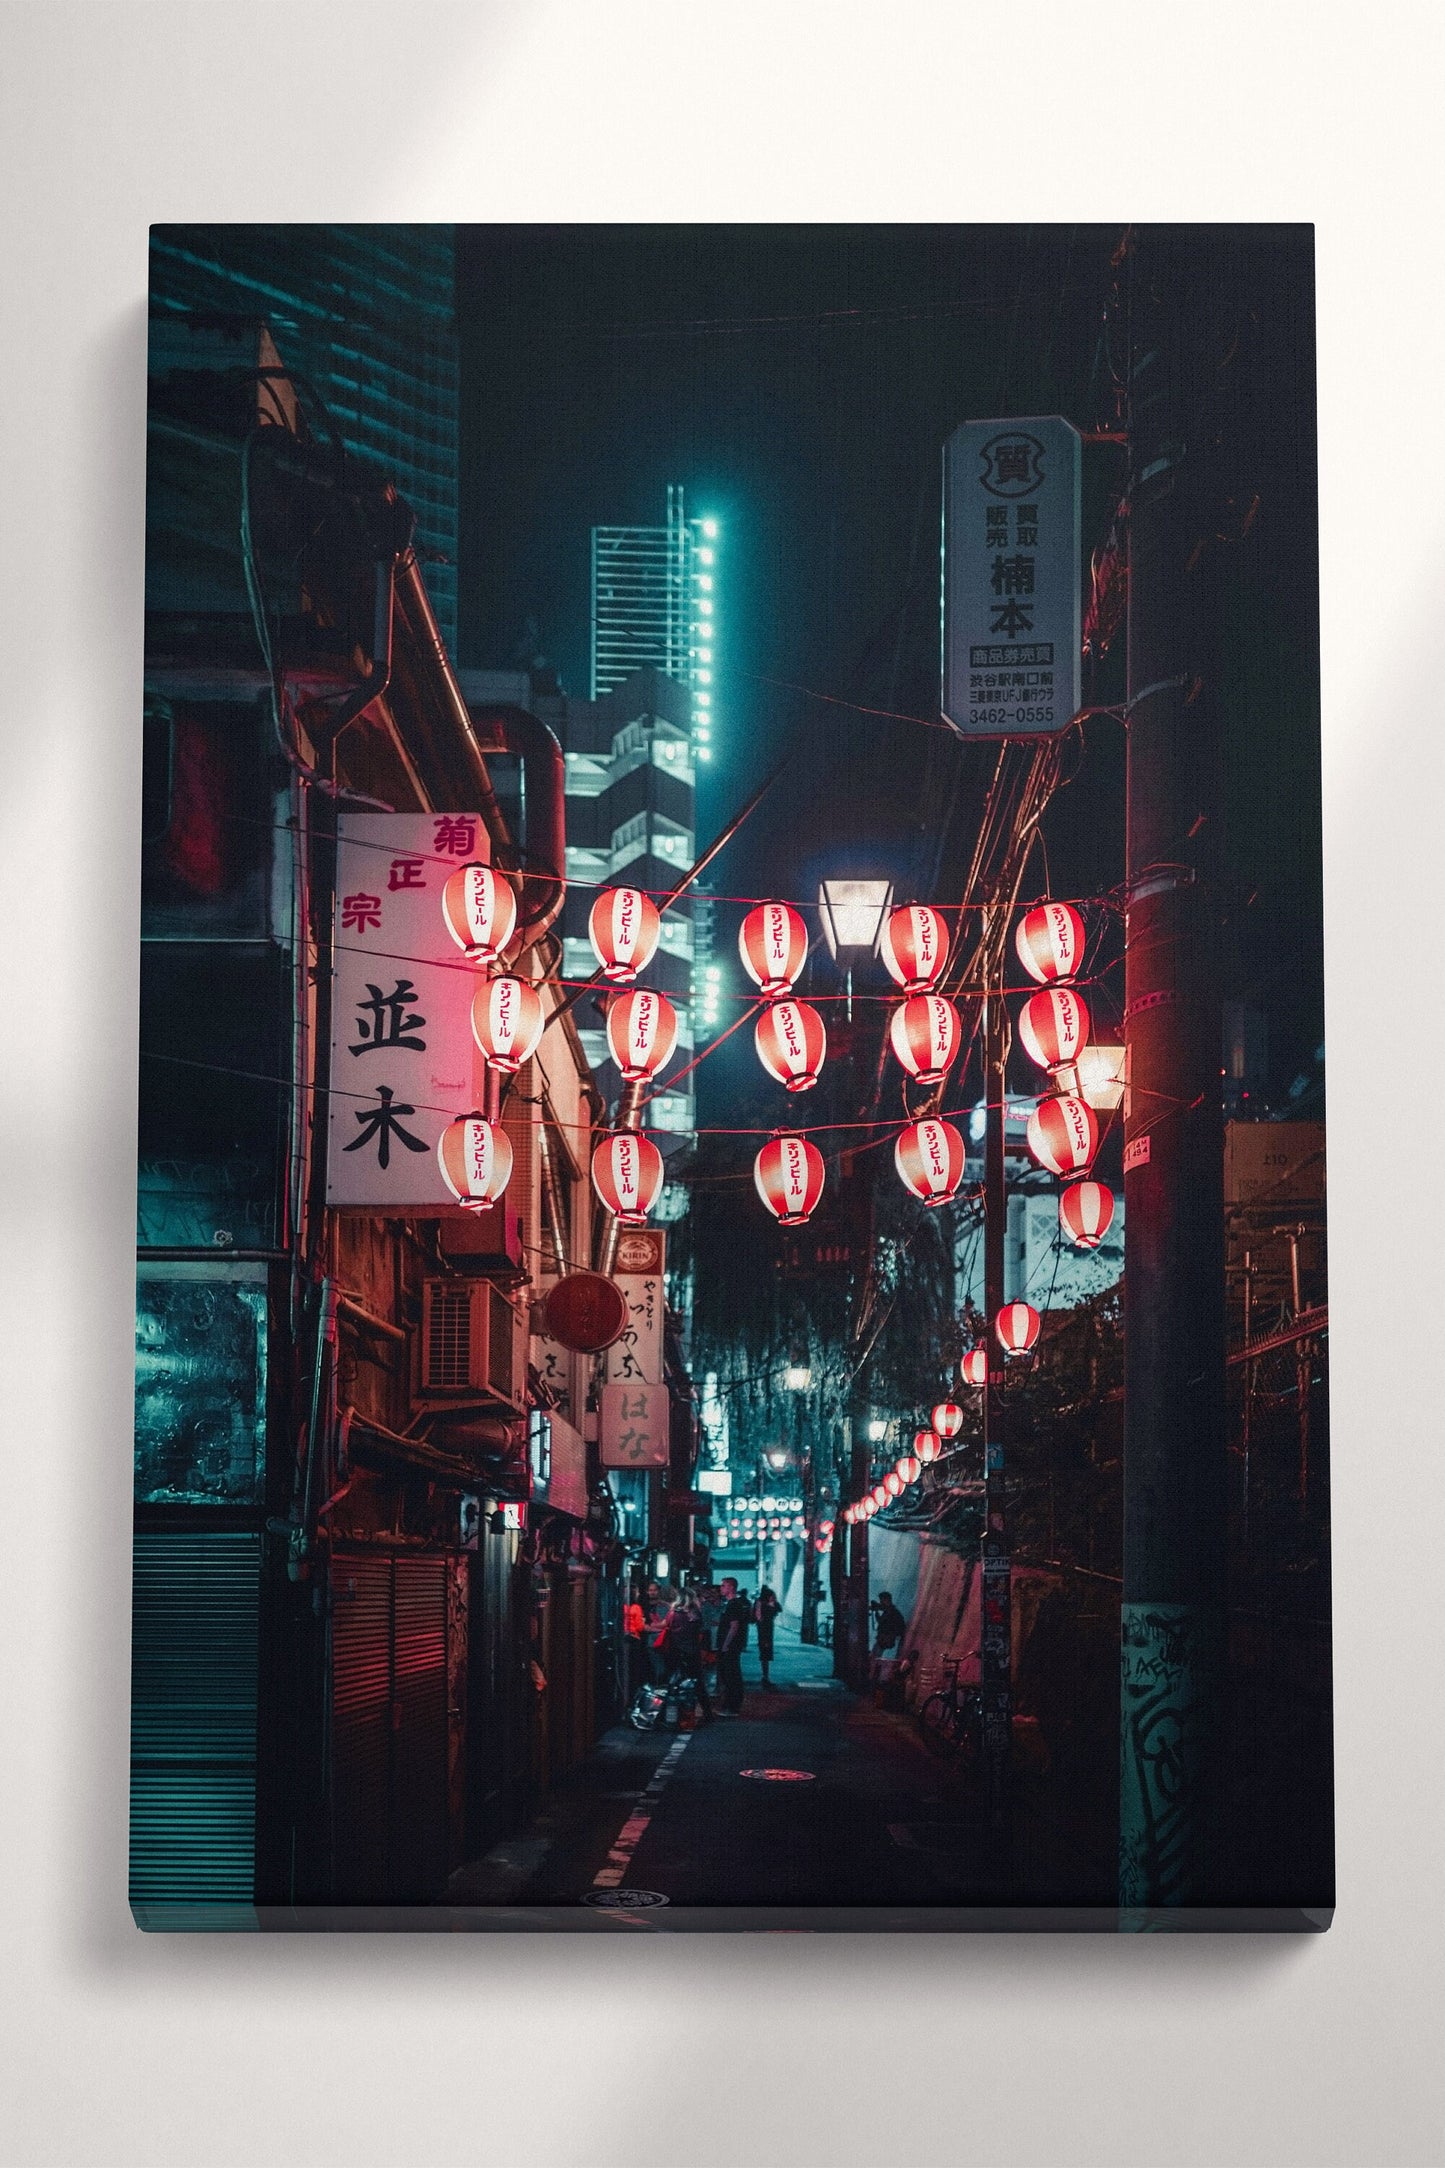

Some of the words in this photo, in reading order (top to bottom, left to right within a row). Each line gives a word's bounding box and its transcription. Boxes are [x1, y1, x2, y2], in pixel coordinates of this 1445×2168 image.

[994, 445, 1032, 484] 質
[990, 554, 1035, 639] 楠本
[969, 706, 1054, 724] 3462-0555
[771, 906, 785, 959] キリンビール
[918, 909, 932, 962] キリンビール
[780, 1005, 801, 1057] キリンビール
[342, 980, 431, 1170] 並木
[643, 1280, 657, 1331] やきとり
[618, 1393, 650, 1460] はな
